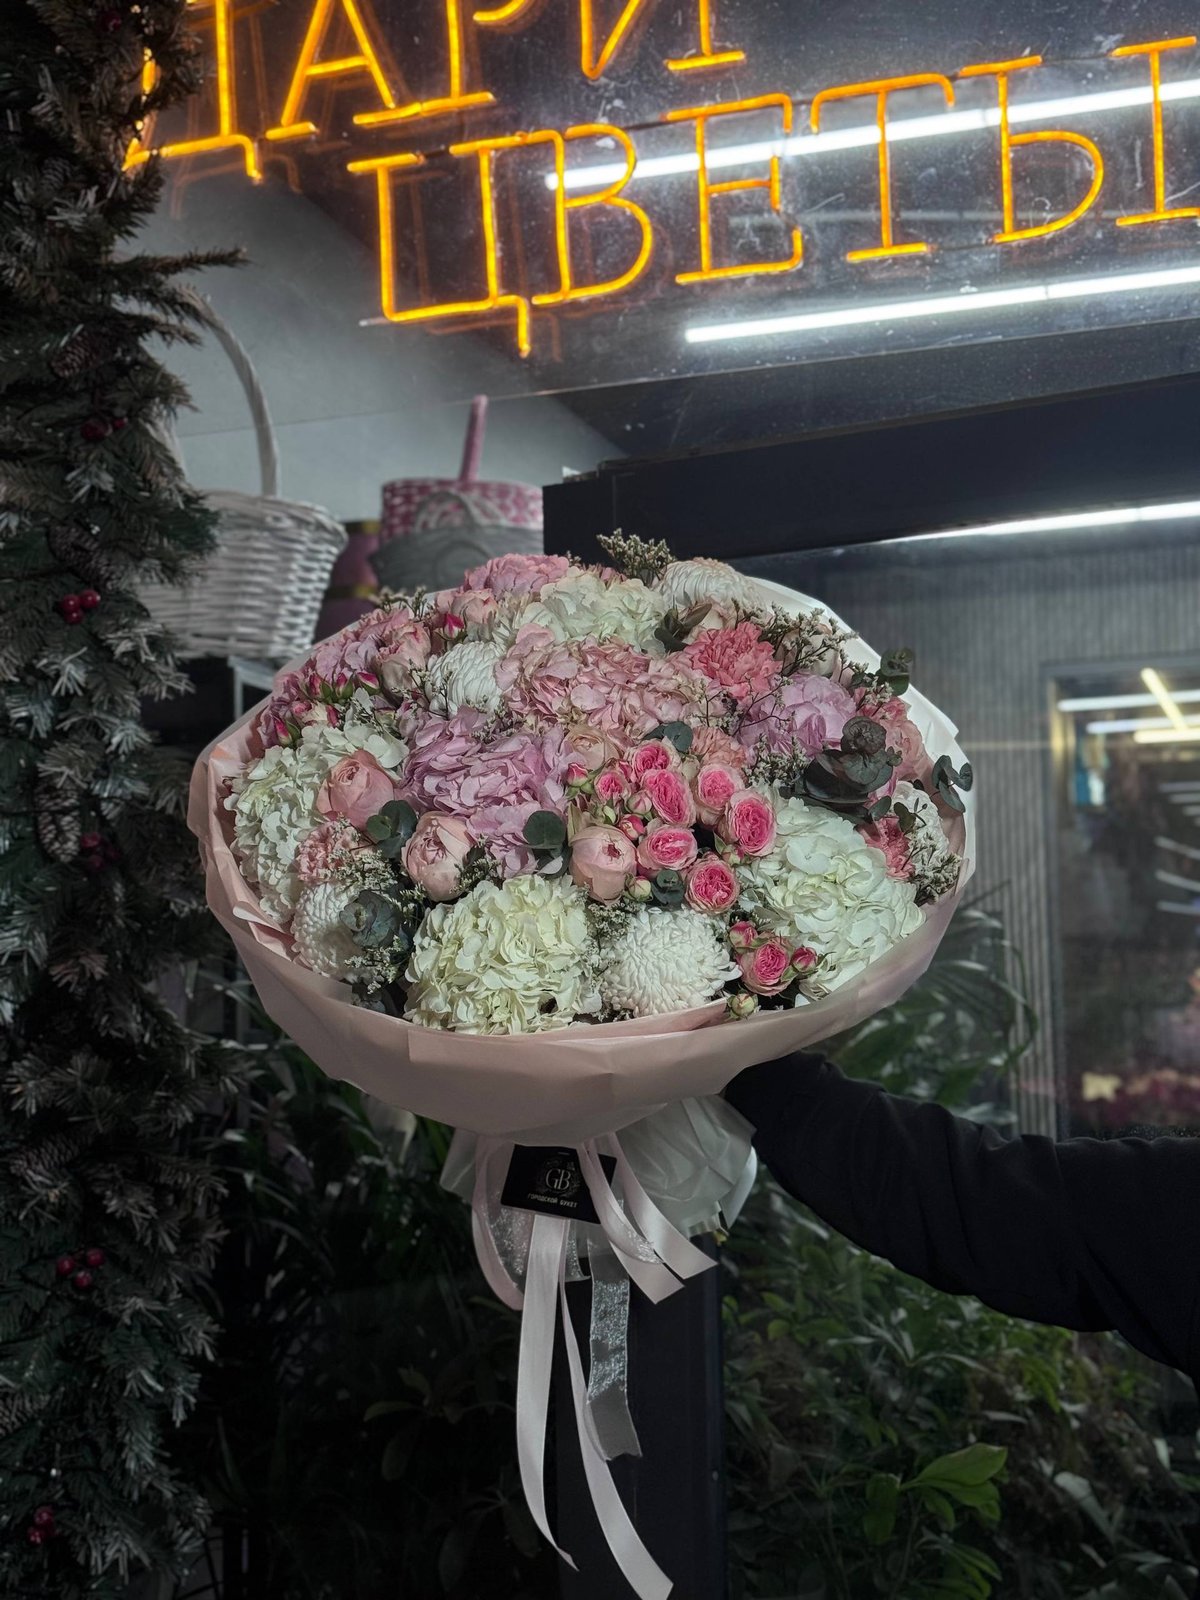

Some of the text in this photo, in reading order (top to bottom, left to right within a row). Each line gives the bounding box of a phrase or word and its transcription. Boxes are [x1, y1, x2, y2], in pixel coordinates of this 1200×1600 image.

[347, 36, 1200, 358] ЦВЕТЫ
[545, 1168, 571, 1190] GB
[527, 1193, 578, 1208] ГОРОДСКОЙ БУКЕТ
